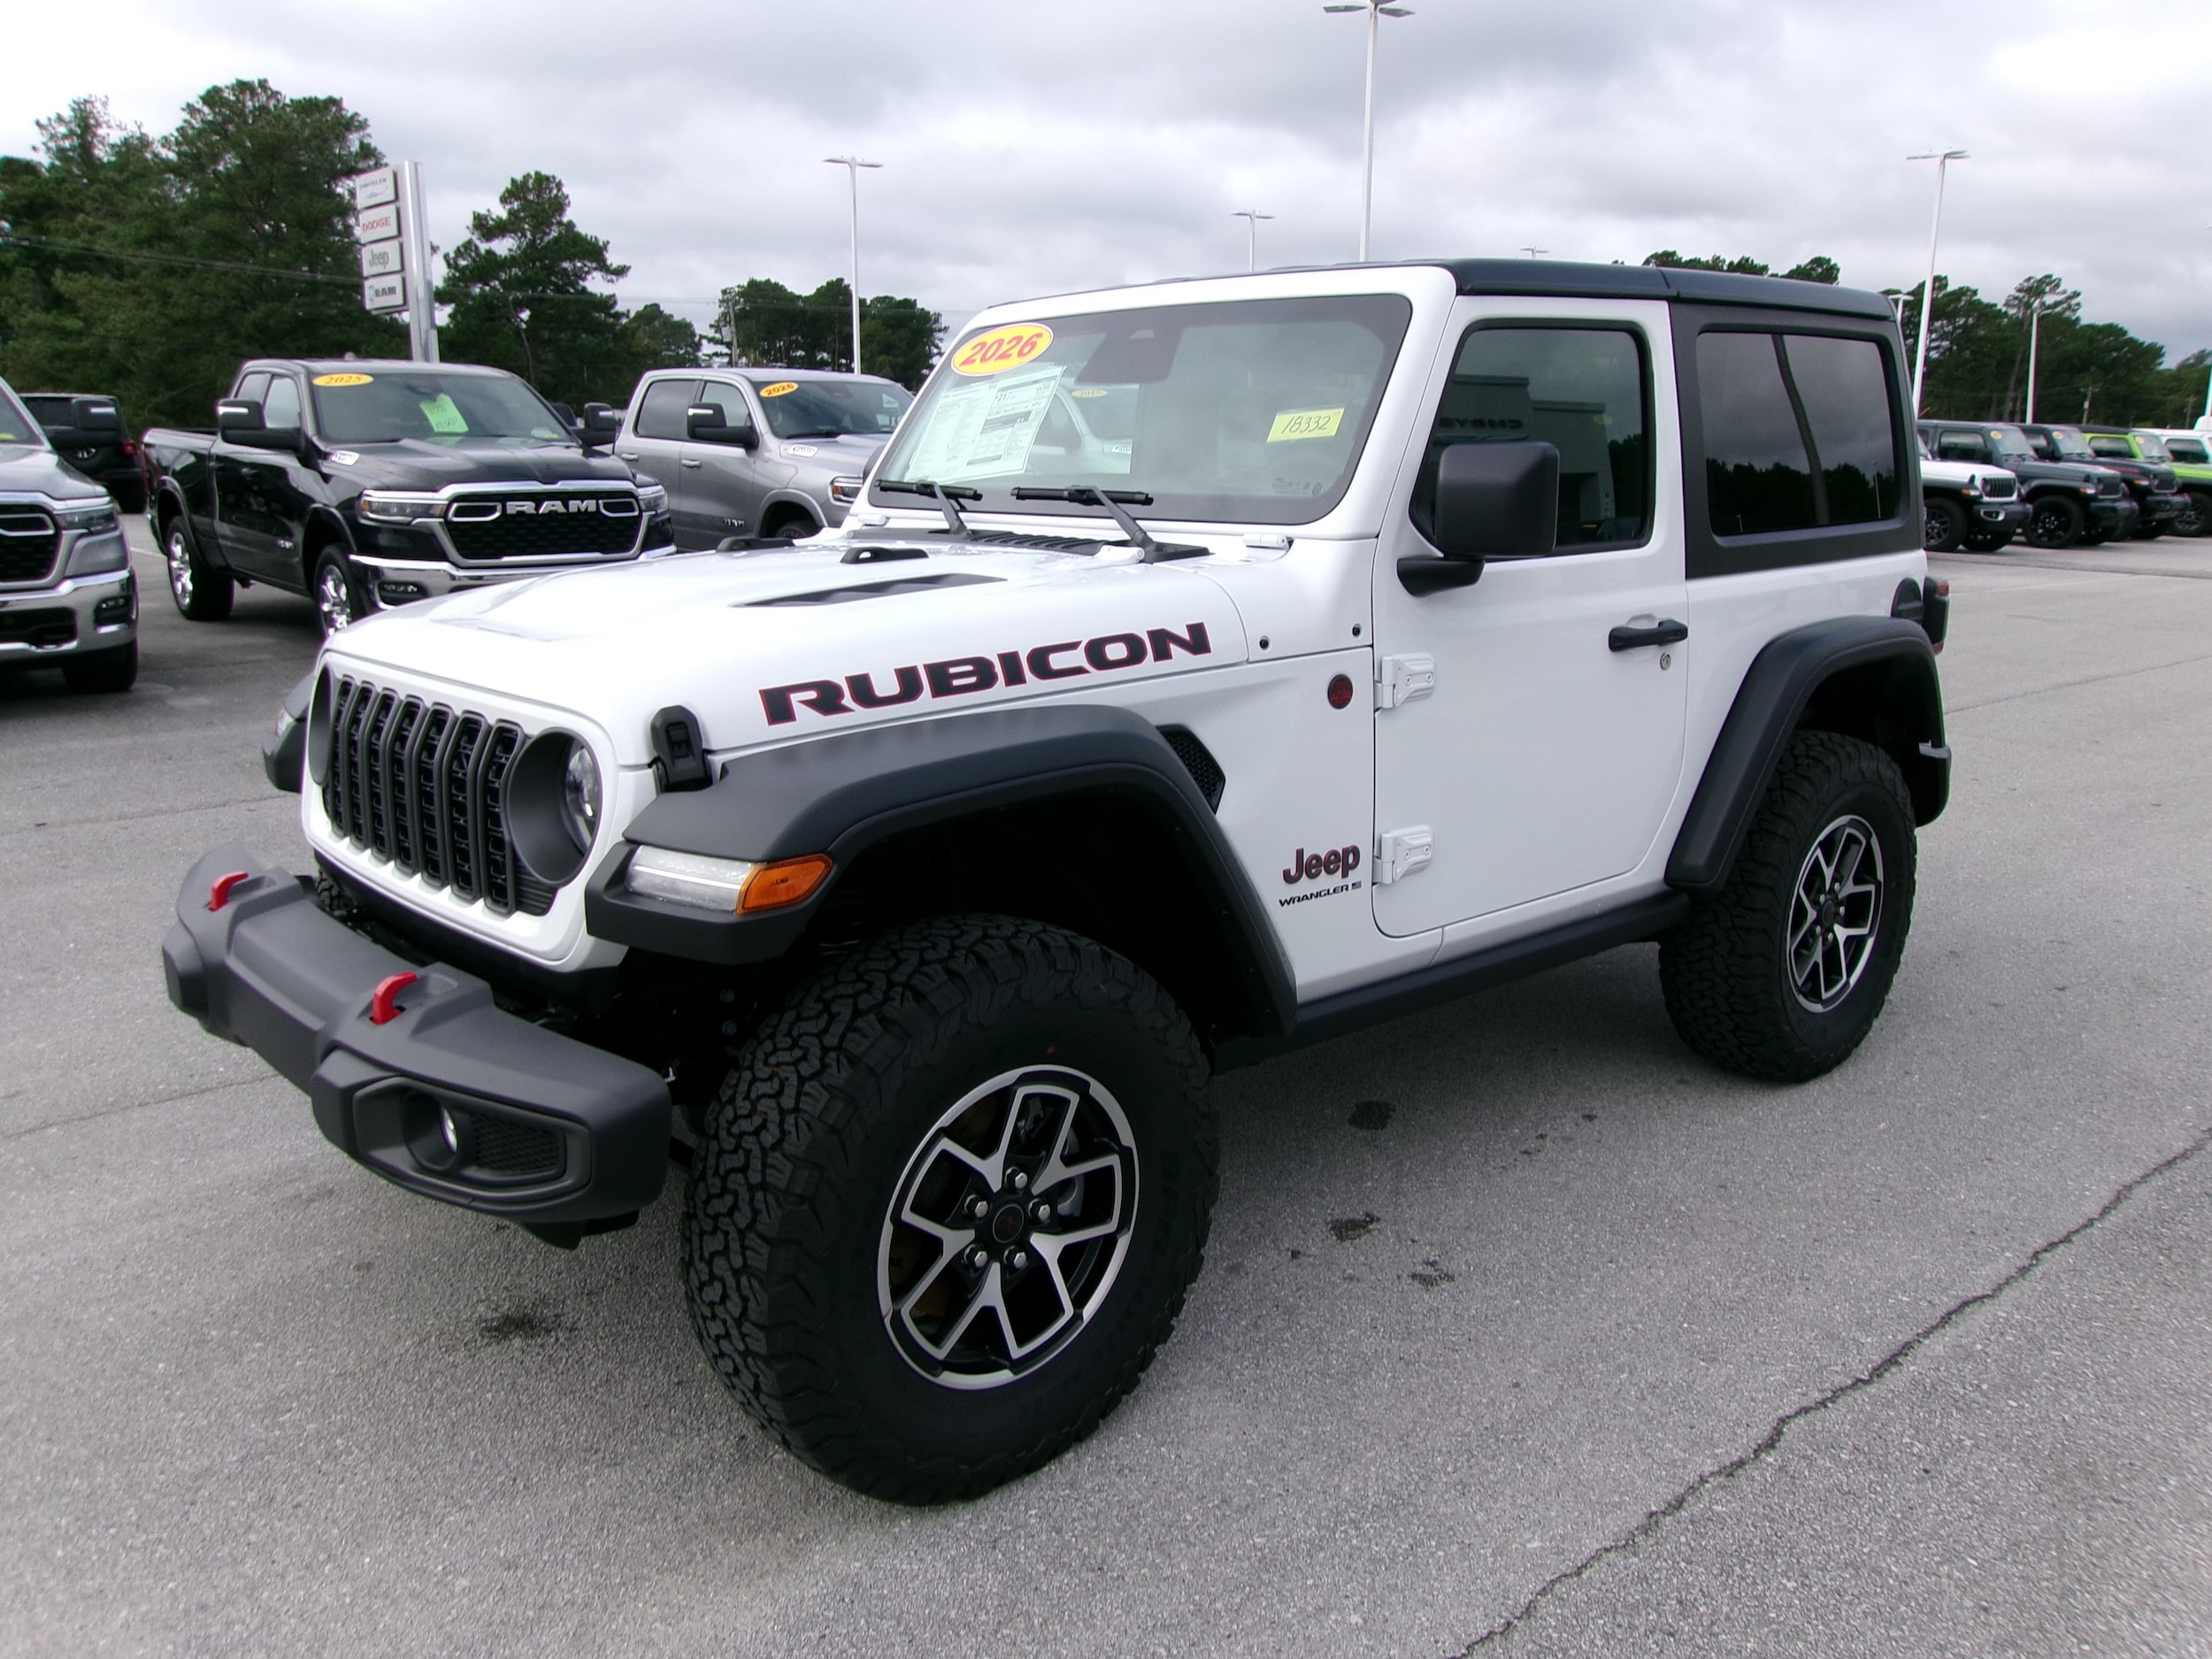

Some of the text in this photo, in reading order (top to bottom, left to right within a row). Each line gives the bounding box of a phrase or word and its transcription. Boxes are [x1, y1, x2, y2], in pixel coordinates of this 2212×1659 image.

[362, 216, 392, 232] DODGE
[368, 248, 389, 269] Jeep
[375, 286, 397, 298] RAM
[958, 332, 1043, 367] 2026
[764, 381, 795, 396] 2026
[1280, 414, 1332, 434] 18332
[505, 499, 597, 516] RAM
[757, 620, 1212, 726] RUBICON
[1282, 844, 1362, 885] Jeep
[1278, 883, 1350, 908] WRANGLER
